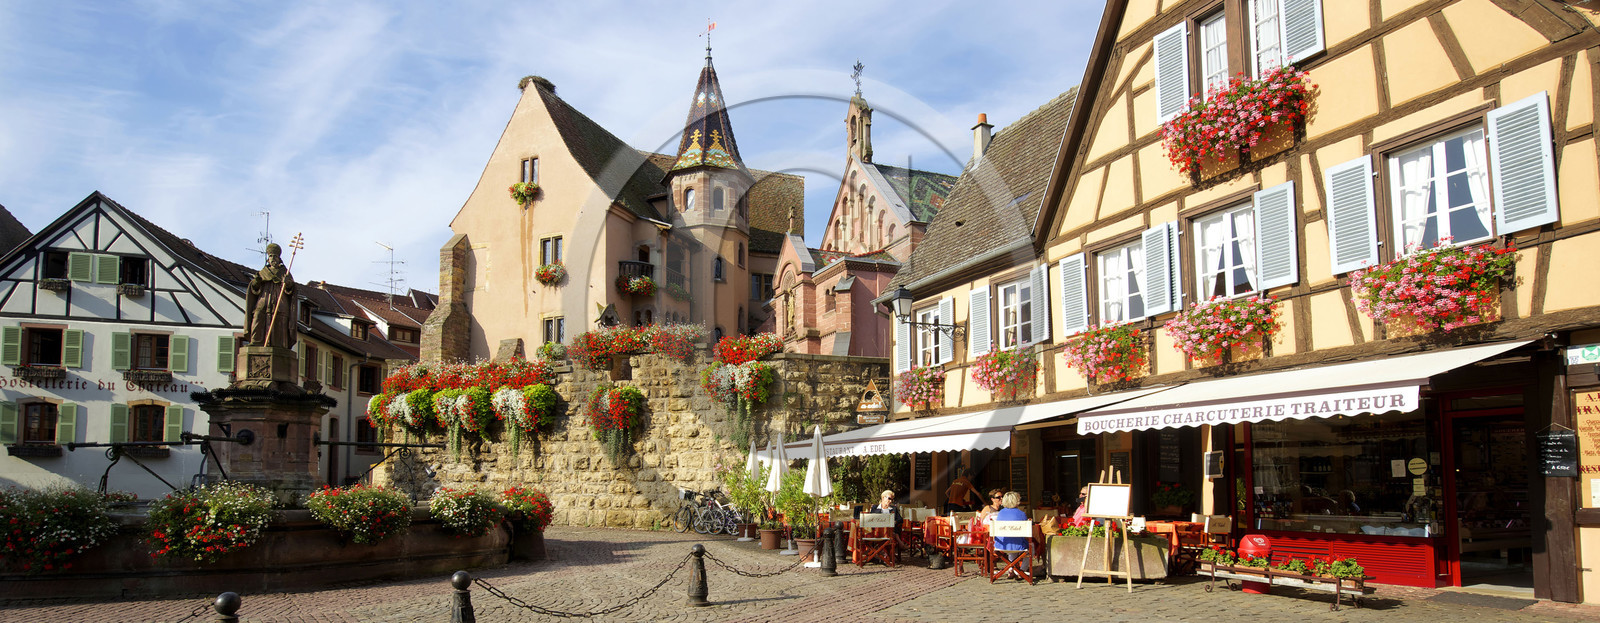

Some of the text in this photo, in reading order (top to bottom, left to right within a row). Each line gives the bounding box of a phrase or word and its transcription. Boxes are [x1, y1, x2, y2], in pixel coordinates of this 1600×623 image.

[98, 378, 115, 391] du
[1585, 392, 1600, 402] A.
[1084, 394, 1406, 432] BOUCHERIE CHARCUTERIE TRAITEUR
[826, 446, 855, 455] STAURANT
[870, 444, 886, 453] EDEL
[1578, 464, 1600, 474] RES
